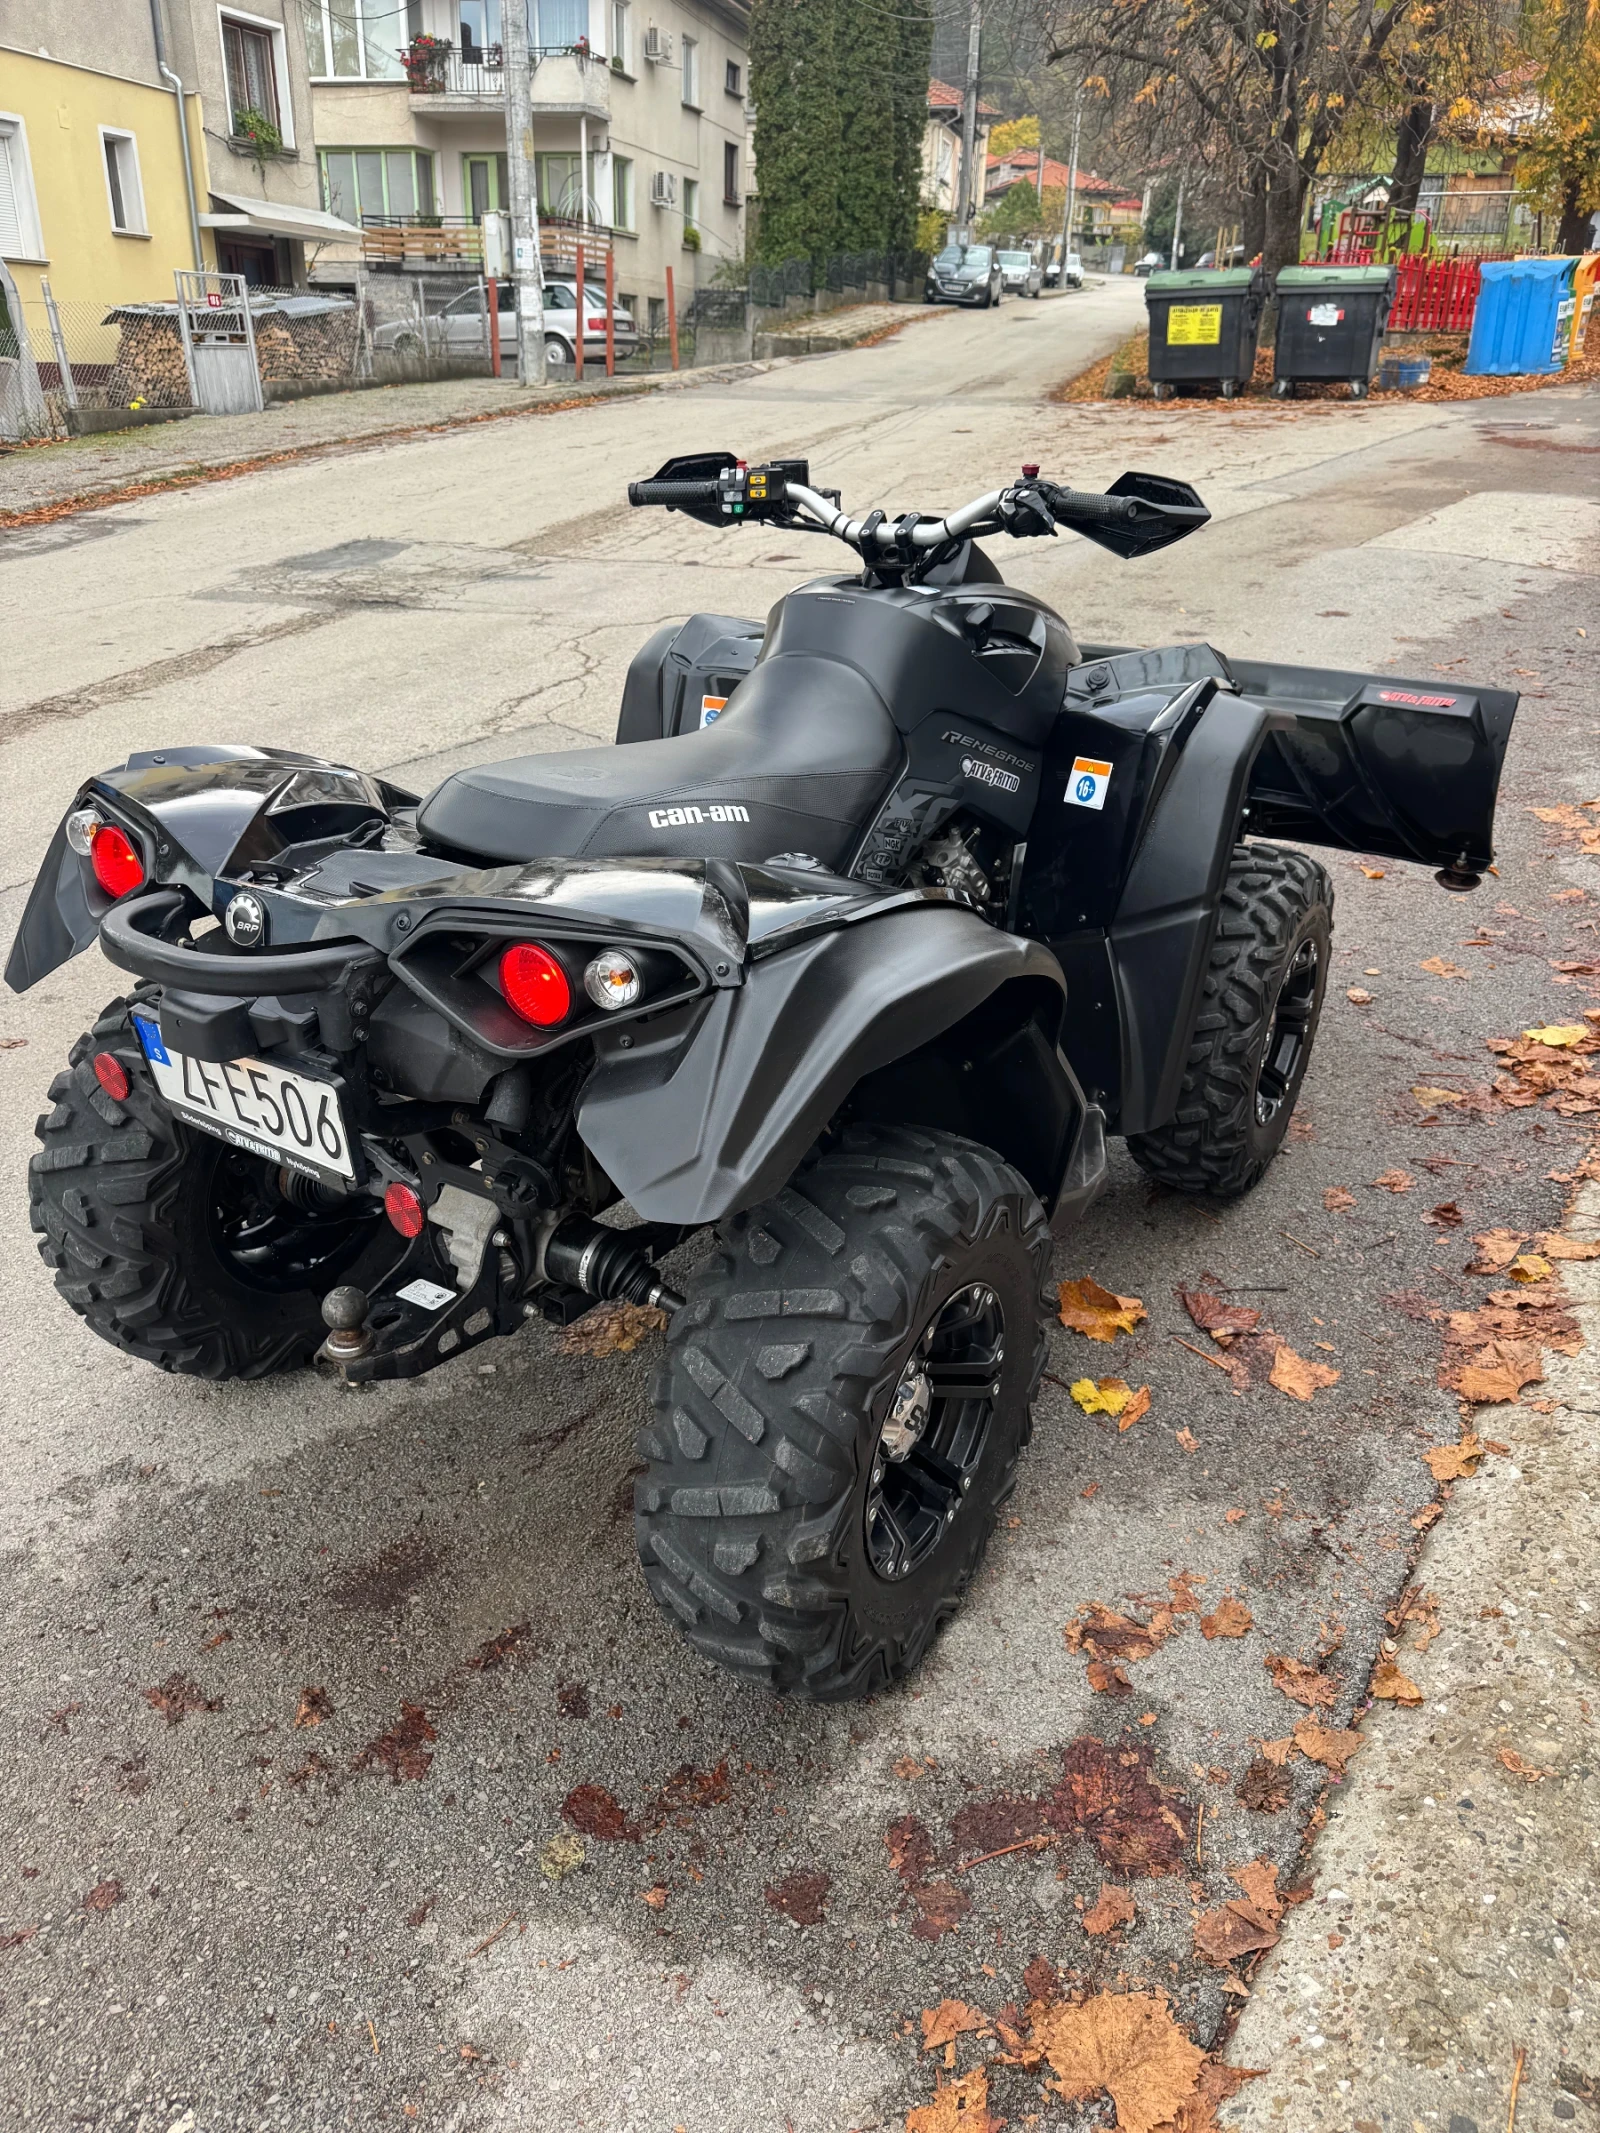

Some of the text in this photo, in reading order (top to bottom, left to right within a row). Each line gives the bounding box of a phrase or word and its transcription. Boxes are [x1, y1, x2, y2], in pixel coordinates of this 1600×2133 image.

[941, 730, 1036, 772] RENEGADE
[648, 805, 750, 829] can-am
[885, 838, 901, 850] NGK
[236, 921, 259, 932] BRP
[153, 1047, 163, 1060] S
